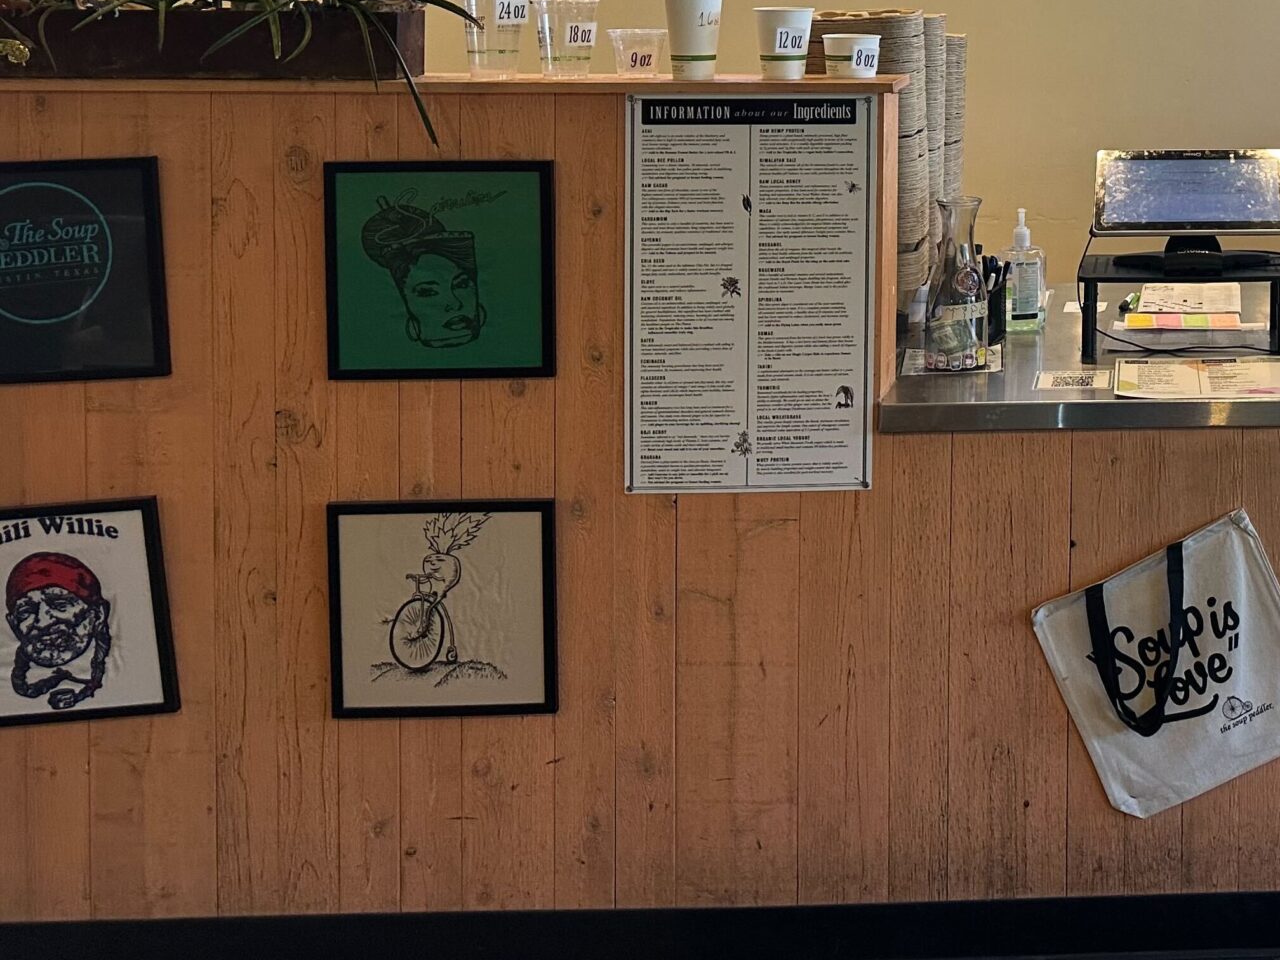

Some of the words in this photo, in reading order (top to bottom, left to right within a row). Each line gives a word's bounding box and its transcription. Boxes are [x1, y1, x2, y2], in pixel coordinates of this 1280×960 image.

[498, 1, 511, 19] 24
[514, 3, 526, 19] oz
[569, 25, 579, 43] 18
[581, 28, 591, 42] oz
[778, 31, 789, 49] 12
[791, 35, 803, 49] oz
[630, 52, 637, 68] 9
[640, 53, 652, 67] oz
[856, 49, 862, 66] 8
[864, 53, 875, 68] oz
[650, 105, 731, 120] INFORMATION
[734, 108, 766, 117] about
[793, 103, 851, 121] Ingredients
[4, 219, 45, 244] The
[48, 218, 100, 242] Soup
[0, 244, 100, 268] EDDLER
[0, 518, 31, 543] ili
[37, 514, 119, 541] Willie
[1207, 596, 1240, 639] is
[1220, 722, 1231, 734] the
[1232, 715, 1248, 729] soup
